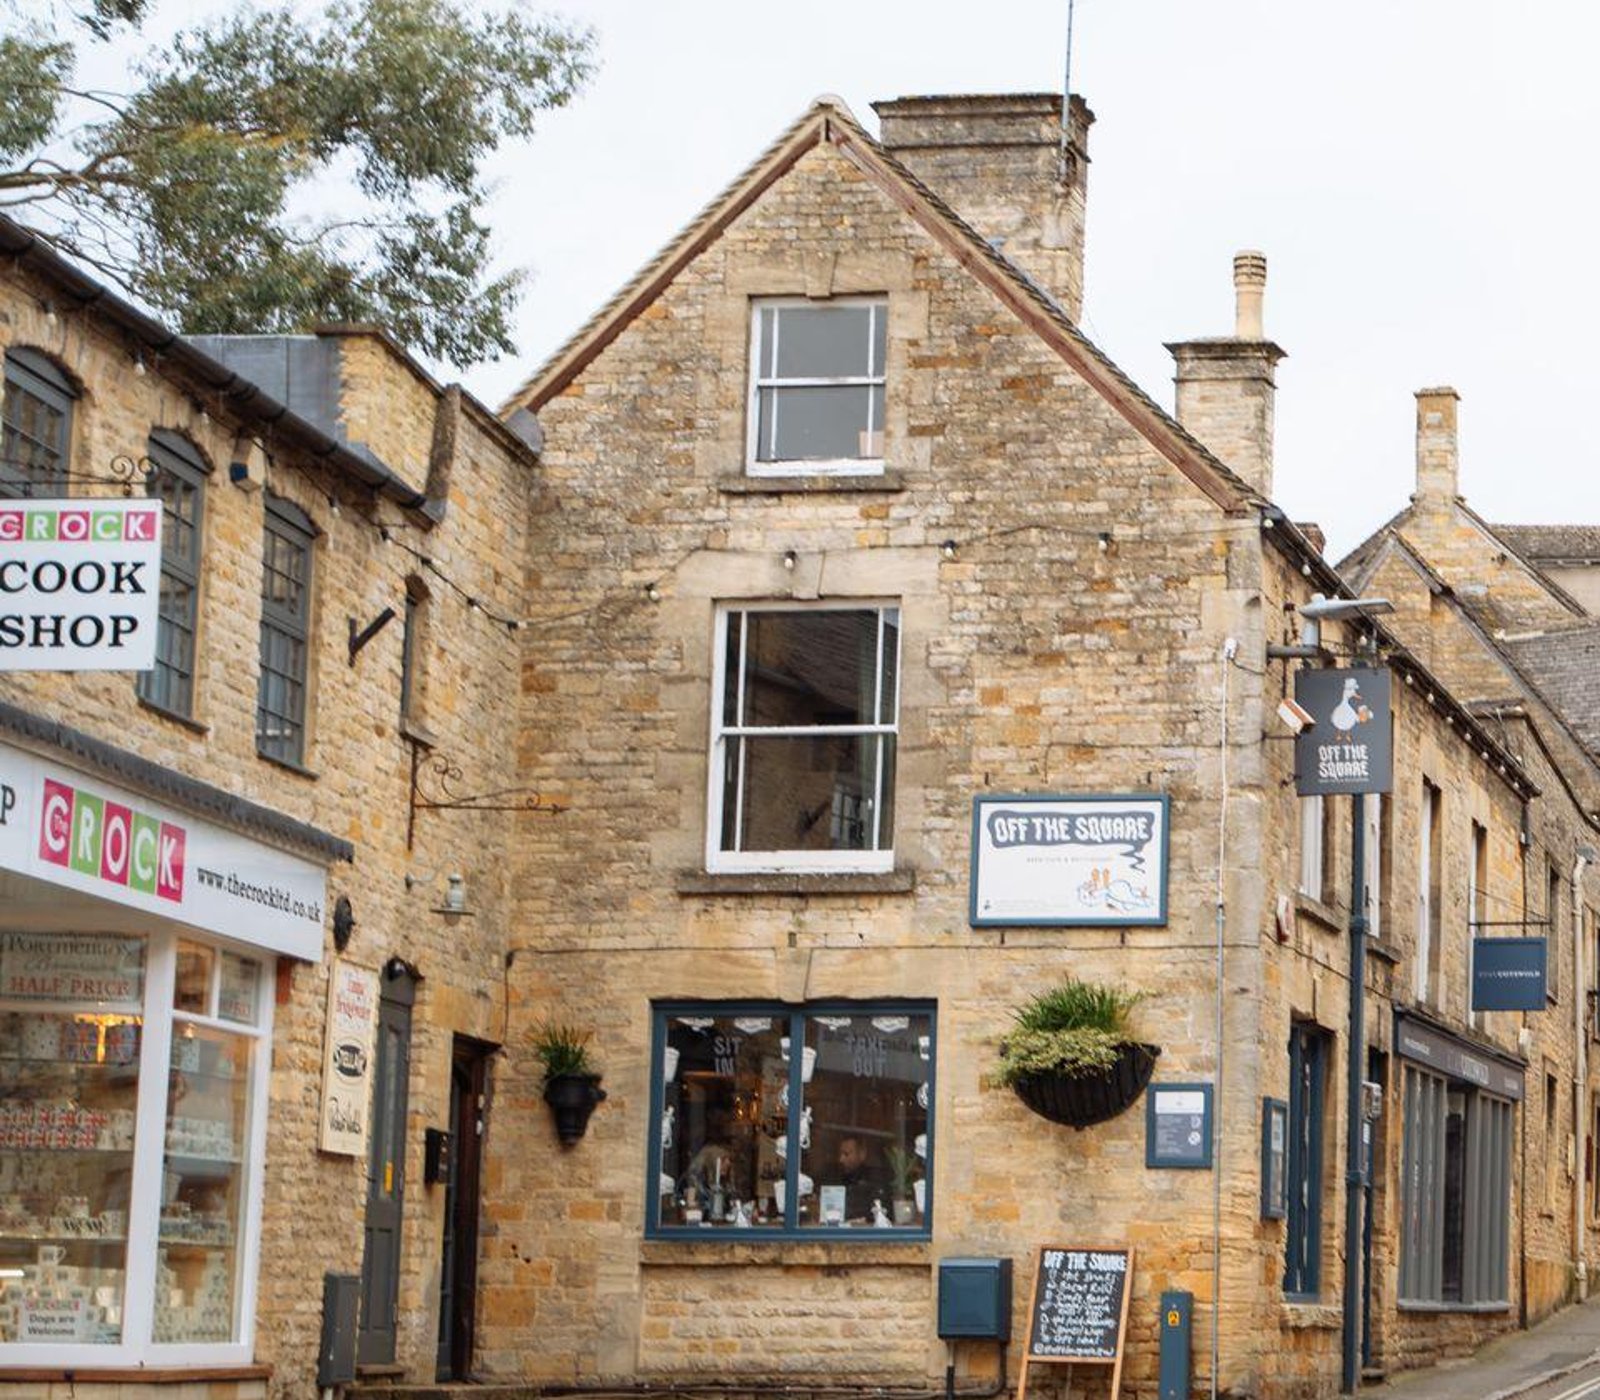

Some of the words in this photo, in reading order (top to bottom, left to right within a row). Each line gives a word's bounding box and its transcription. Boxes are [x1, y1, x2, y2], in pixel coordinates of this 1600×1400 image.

[0, 513, 147, 540] CROCK
[0, 560, 146, 594] COOK
[0, 614, 139, 648] SHOP
[1318, 744, 1340, 762] OFF
[1342, 744, 1368, 760] THE
[1318, 761, 1369, 780] SQUARE
[994, 816, 1030, 843] OFF
[1031, 817, 1071, 841] THE
[1074, 816, 1149, 843] SQUARE
[43, 794, 180, 890] CROCK
[714, 1036, 741, 1054] SIT
[846, 1036, 887, 1054] TAKE
[715, 1058, 735, 1076] IN
[854, 1057, 887, 1077] OUT
[1066, 1251, 1087, 1271] THE
[29, 1313, 56, 1325] Dogs
[59, 1314, 76, 1322] are
[28, 1325, 76, 1335] Welcome
